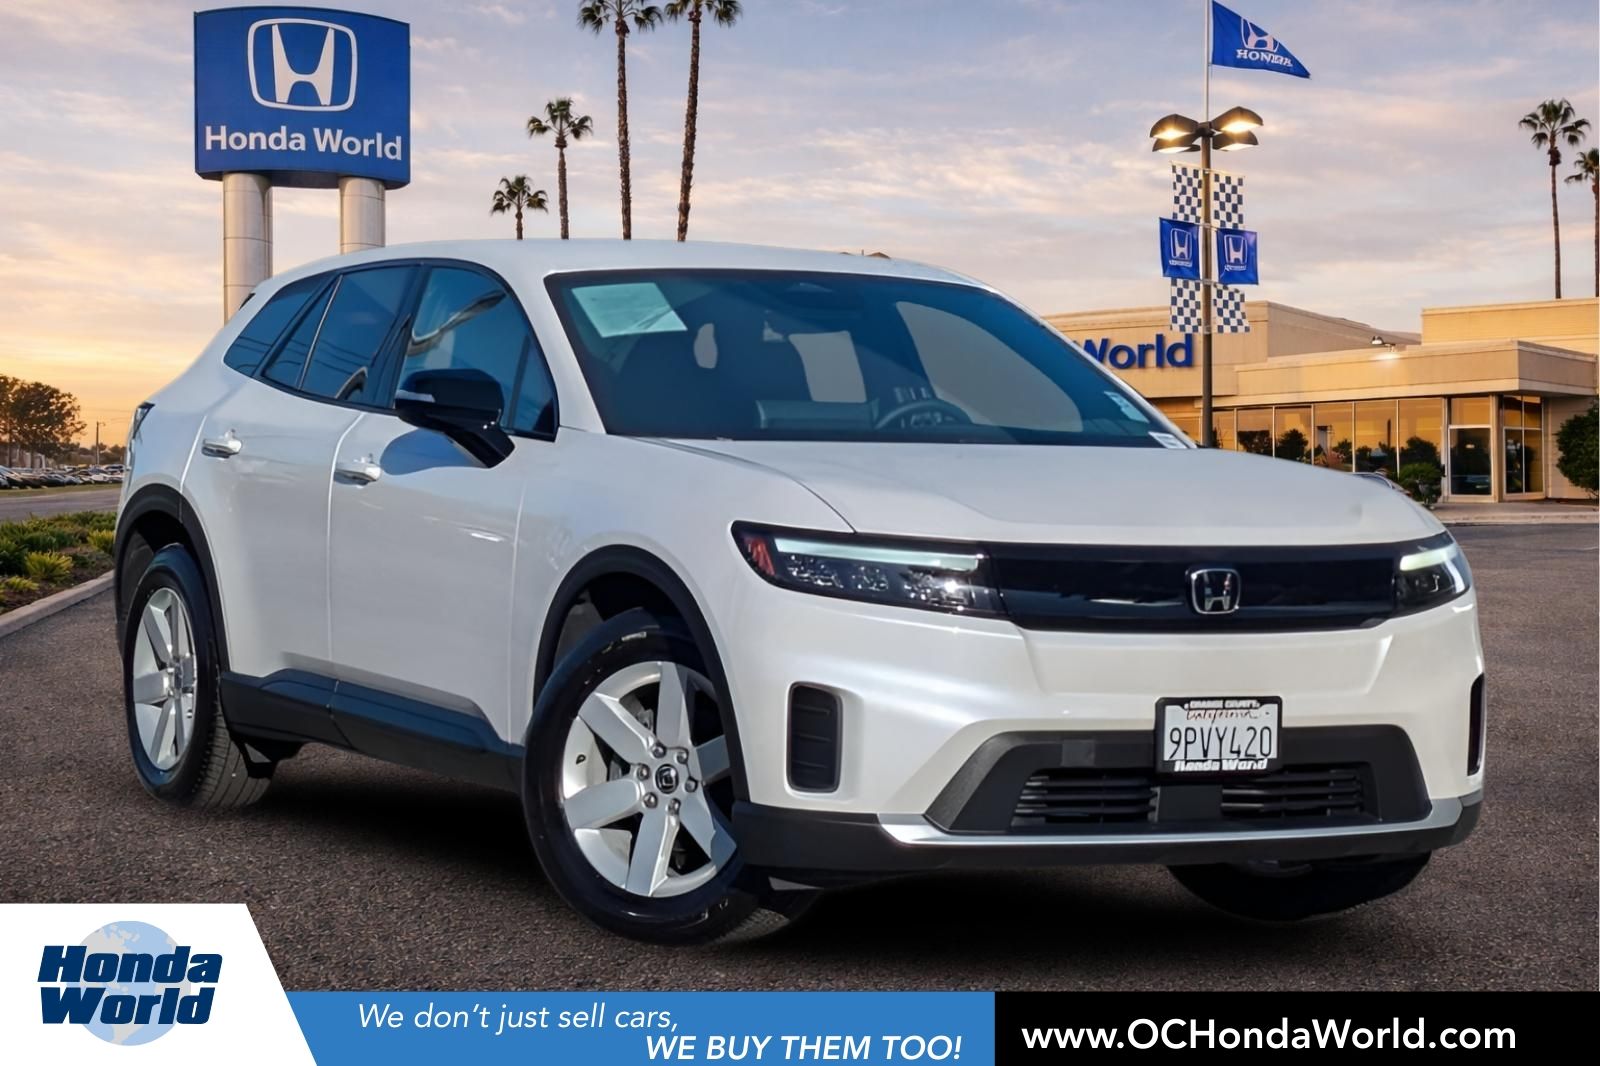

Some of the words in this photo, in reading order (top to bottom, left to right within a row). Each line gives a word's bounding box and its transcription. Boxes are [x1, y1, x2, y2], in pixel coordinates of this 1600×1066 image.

[1236, 49, 1293, 67] HONDA
[205, 125, 306, 151] Honda
[313, 127, 402, 161] World
[1169, 726, 1272, 760] 9PVY420
